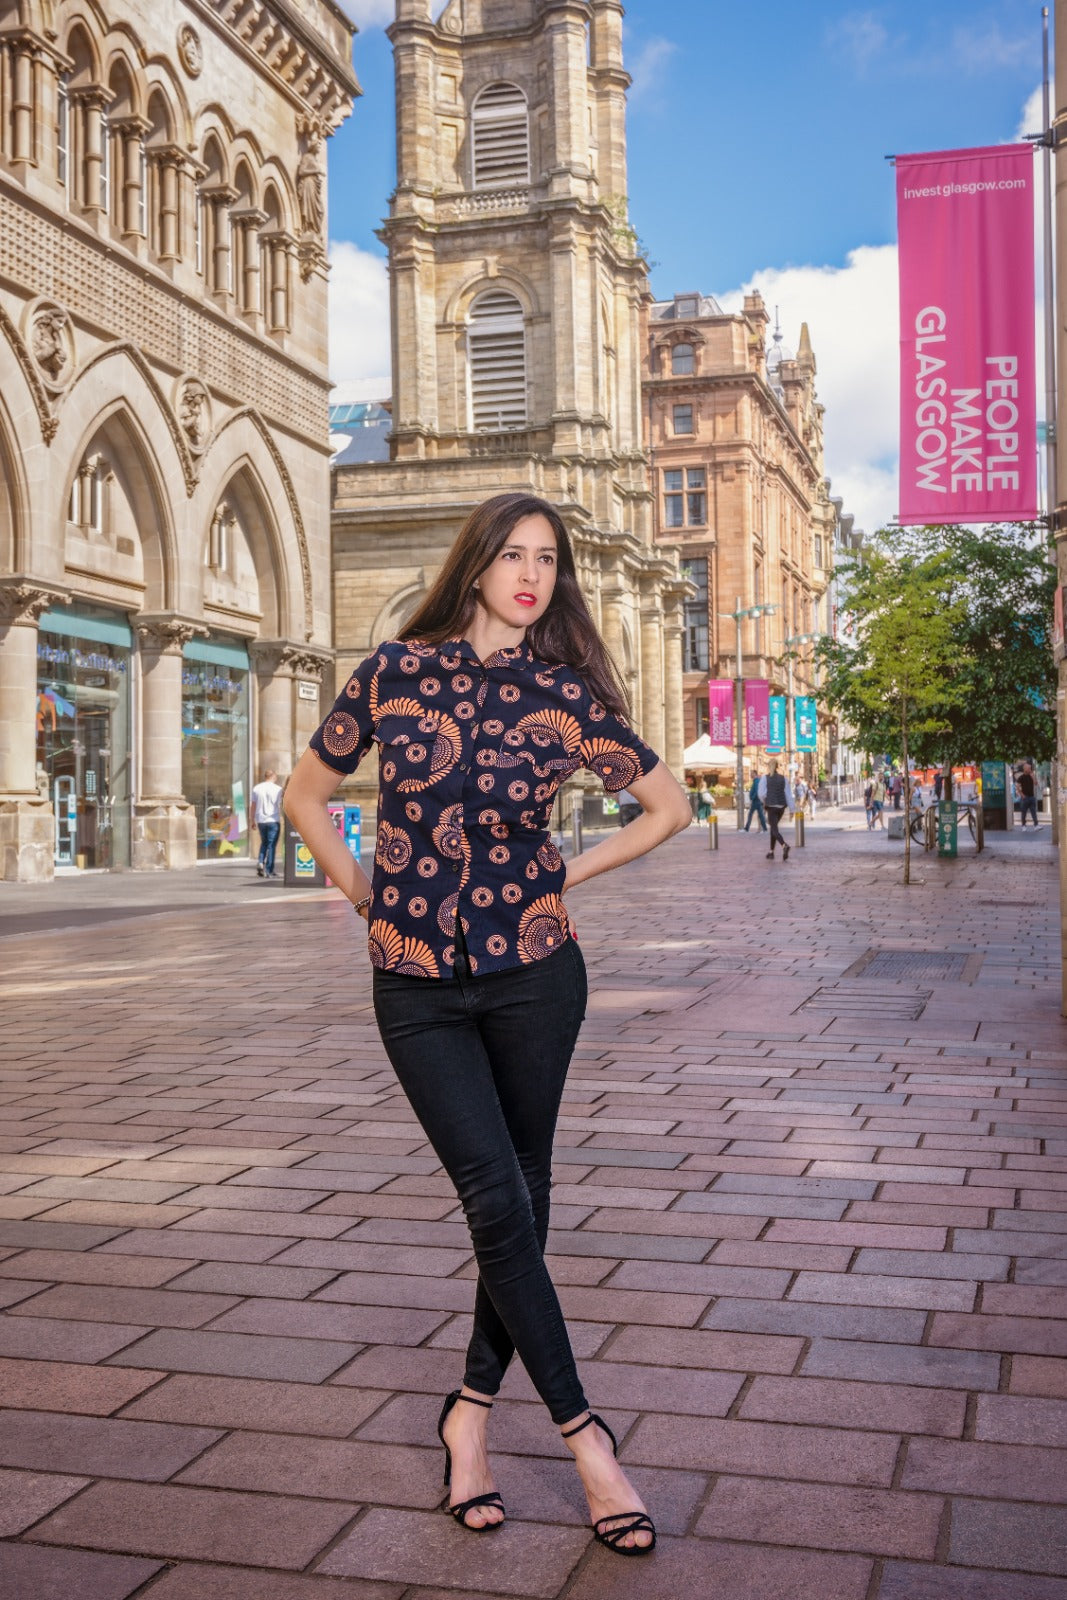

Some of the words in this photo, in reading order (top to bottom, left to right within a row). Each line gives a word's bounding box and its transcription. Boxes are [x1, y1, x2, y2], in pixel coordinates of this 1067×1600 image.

[914, 305, 947, 494] GLASGOW
[950, 387, 983, 493] MAKE
[985, 355, 1019, 492] PEOPLE
